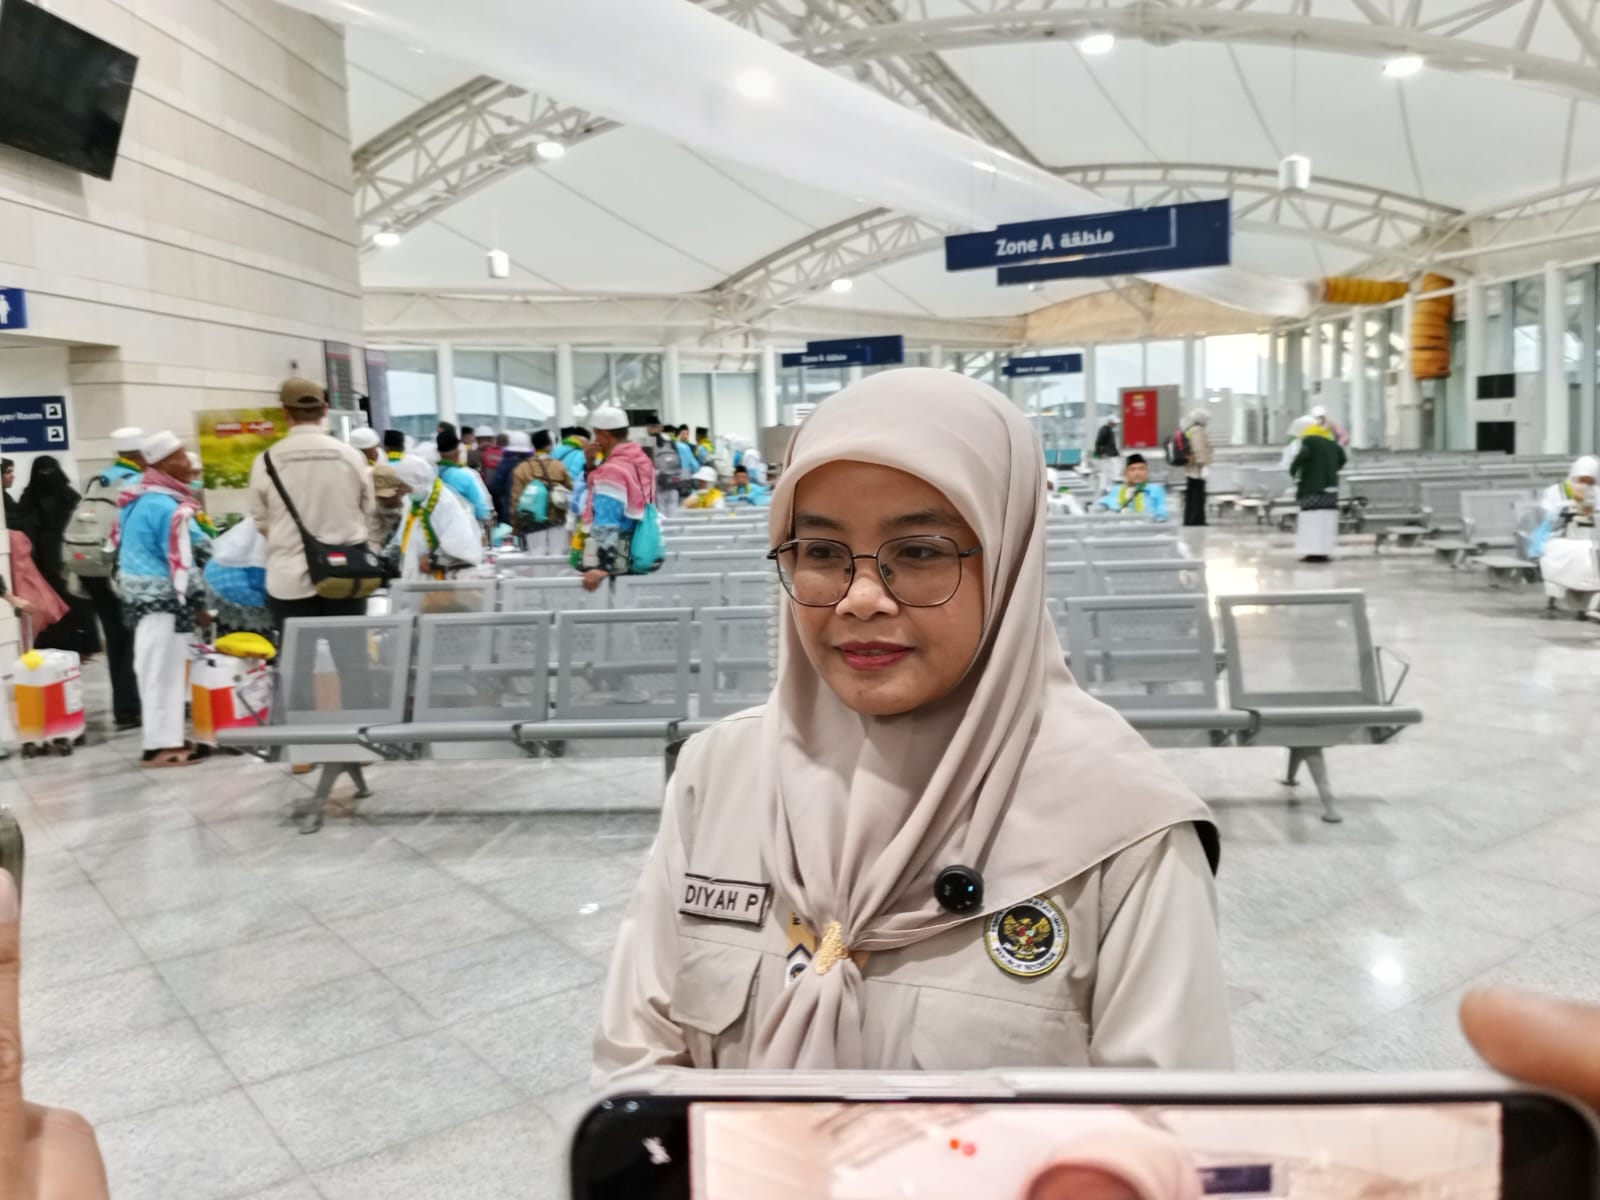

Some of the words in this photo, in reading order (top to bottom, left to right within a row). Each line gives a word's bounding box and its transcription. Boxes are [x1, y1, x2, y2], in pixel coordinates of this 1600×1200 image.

[996, 238, 1038, 256] Zone
[1041, 233, 1055, 251] A
[685, 884, 739, 911] DIYAH
[745, 893, 759, 912] P
